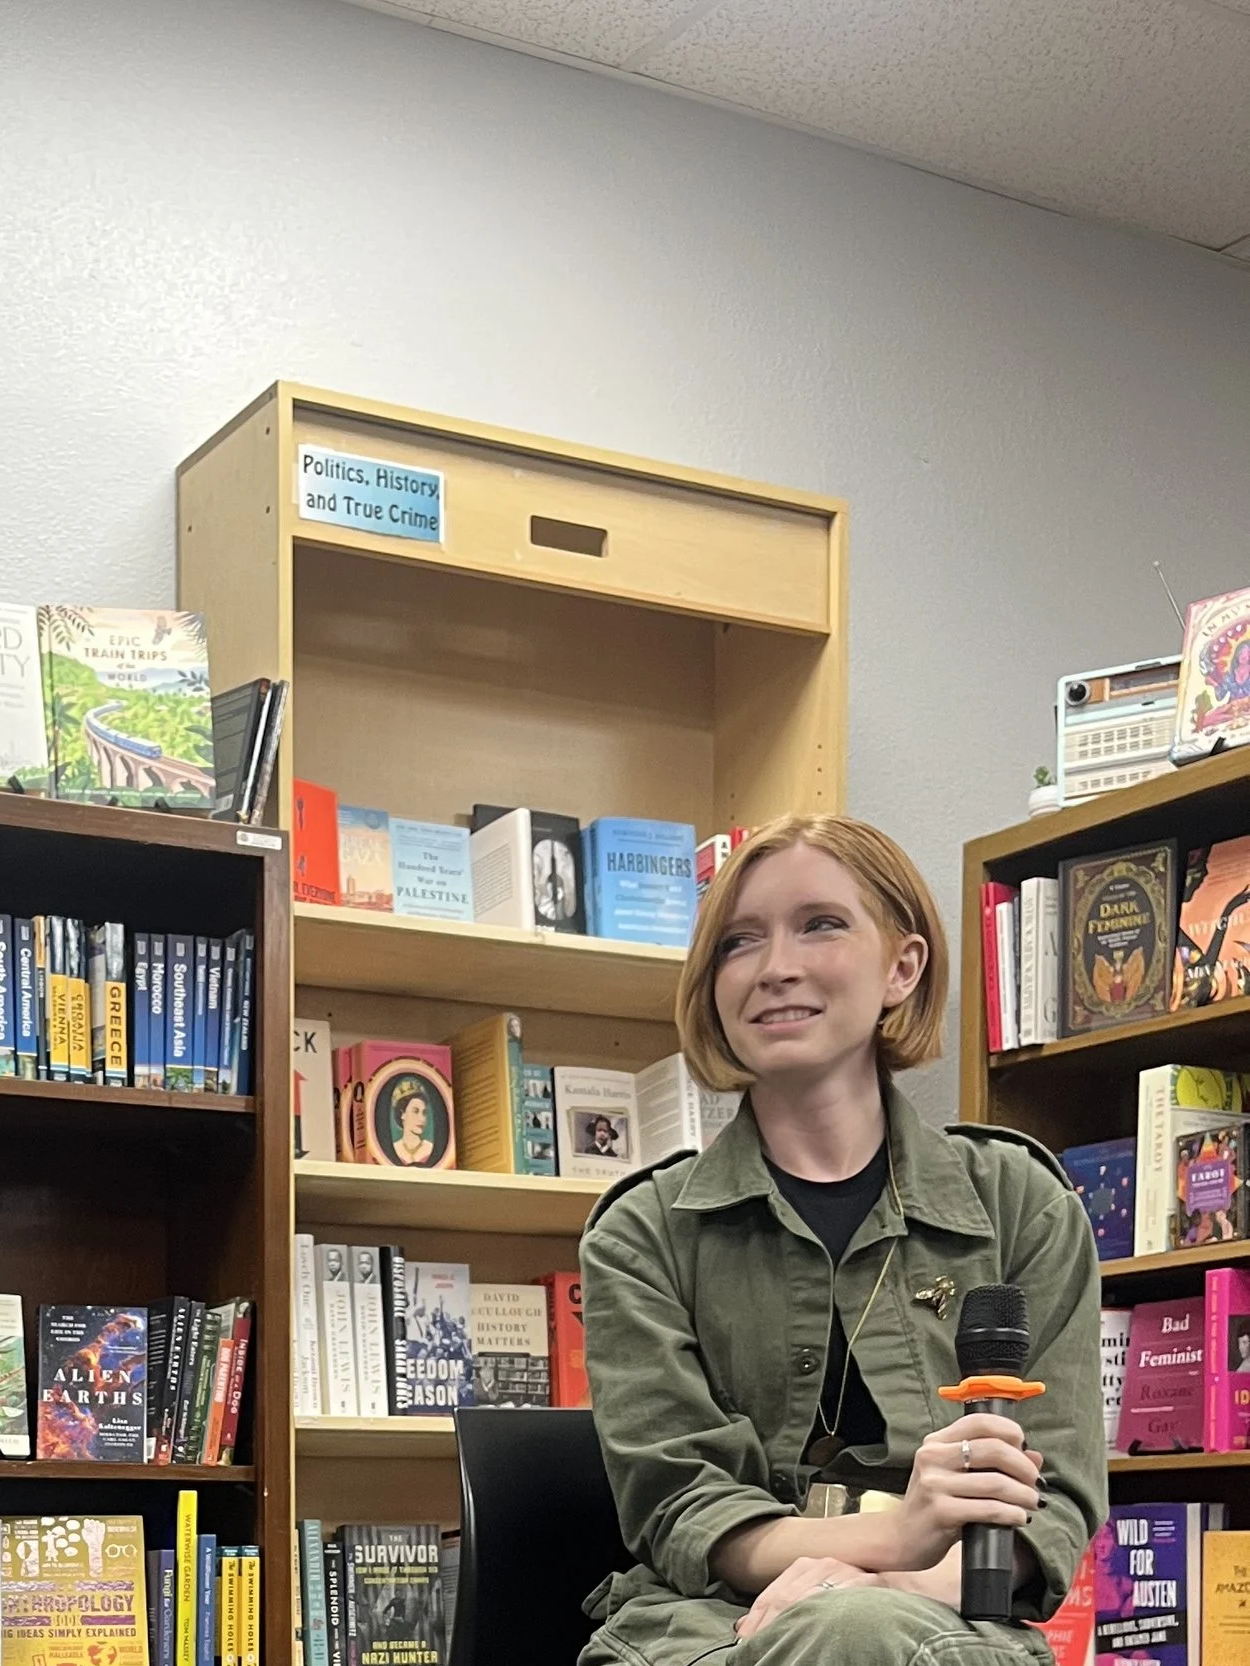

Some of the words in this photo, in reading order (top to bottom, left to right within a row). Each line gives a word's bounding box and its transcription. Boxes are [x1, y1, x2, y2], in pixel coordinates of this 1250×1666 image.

[303, 454, 370, 486] Politics,
[306, 492, 338, 513] and
[344, 496, 384, 520] True
[389, 504, 439, 531] Crime
[84, 647, 125, 660] TRAIN
[130, 649, 168, 661] TRIPS
[109, 635, 141, 647] EPIC
[108, 673, 147, 682] WORLD
[607, 851, 692, 879] HARBINGERS
[417, 875, 434, 885] War
[396, 886, 469, 904] PALESTINE
[1099, 900, 1140, 918] DARK
[1088, 911, 1151, 935] FEMININE
[20, 947, 32, 989] Central
[135, 961, 148, 991] Egypt
[151, 962, 164, 1015] Morocco
[173, 963, 188, 1028] Southeast
[208, 966, 221, 1010] Vietnam
[21, 990, 33, 1037] America
[57, 993, 67, 1045] VIENNA
[109, 986, 122, 1066] GREECE
[173, 1029, 186, 1058] Asia
[564, 1084, 600, 1097] Kamala
[1155, 1087, 1165, 1114] THE
[1154, 1120, 1165, 1172] TAROT
[483, 1292, 520, 1302] DAVID
[335, 1289, 348, 1334] JOHN
[367, 1292, 379, 1335] JOHN
[1161, 1313, 1190, 1334] Bad
[476, 1335, 531, 1347] MATTERS
[477, 1321, 527, 1334] HISTORY
[338, 1340, 350, 1394] LEWIS
[370, 1342, 381, 1395] LEWIS
[406, 1358, 464, 1381] EEDOM
[1139, 1346, 1203, 1368] Feminist
[54, 1368, 131, 1384] ALIEN
[42, 1389, 143, 1406] EARTHS
[183, 1514, 191, 1564] WATERWISE
[1116, 1519, 1149, 1546] WILD
[355, 1544, 439, 1564] SURVIVOR
[1129, 1549, 1154, 1576] FOR
[163, 1569, 173, 1600] Fungi
[1132, 1580, 1177, 1608] AUSTEN
[328, 1571, 339, 1626] SPLENDID
[17, 1629, 45, 1639] IDEAS
[48, 1628, 83, 1639] SIMPLY
[85, 1627, 137, 1638] EXPLAINED
[247, 1622, 255, 1652] HOLES
[361, 1651, 390, 1665] NAZI
[393, 1650, 439, 1664] HUNTER
